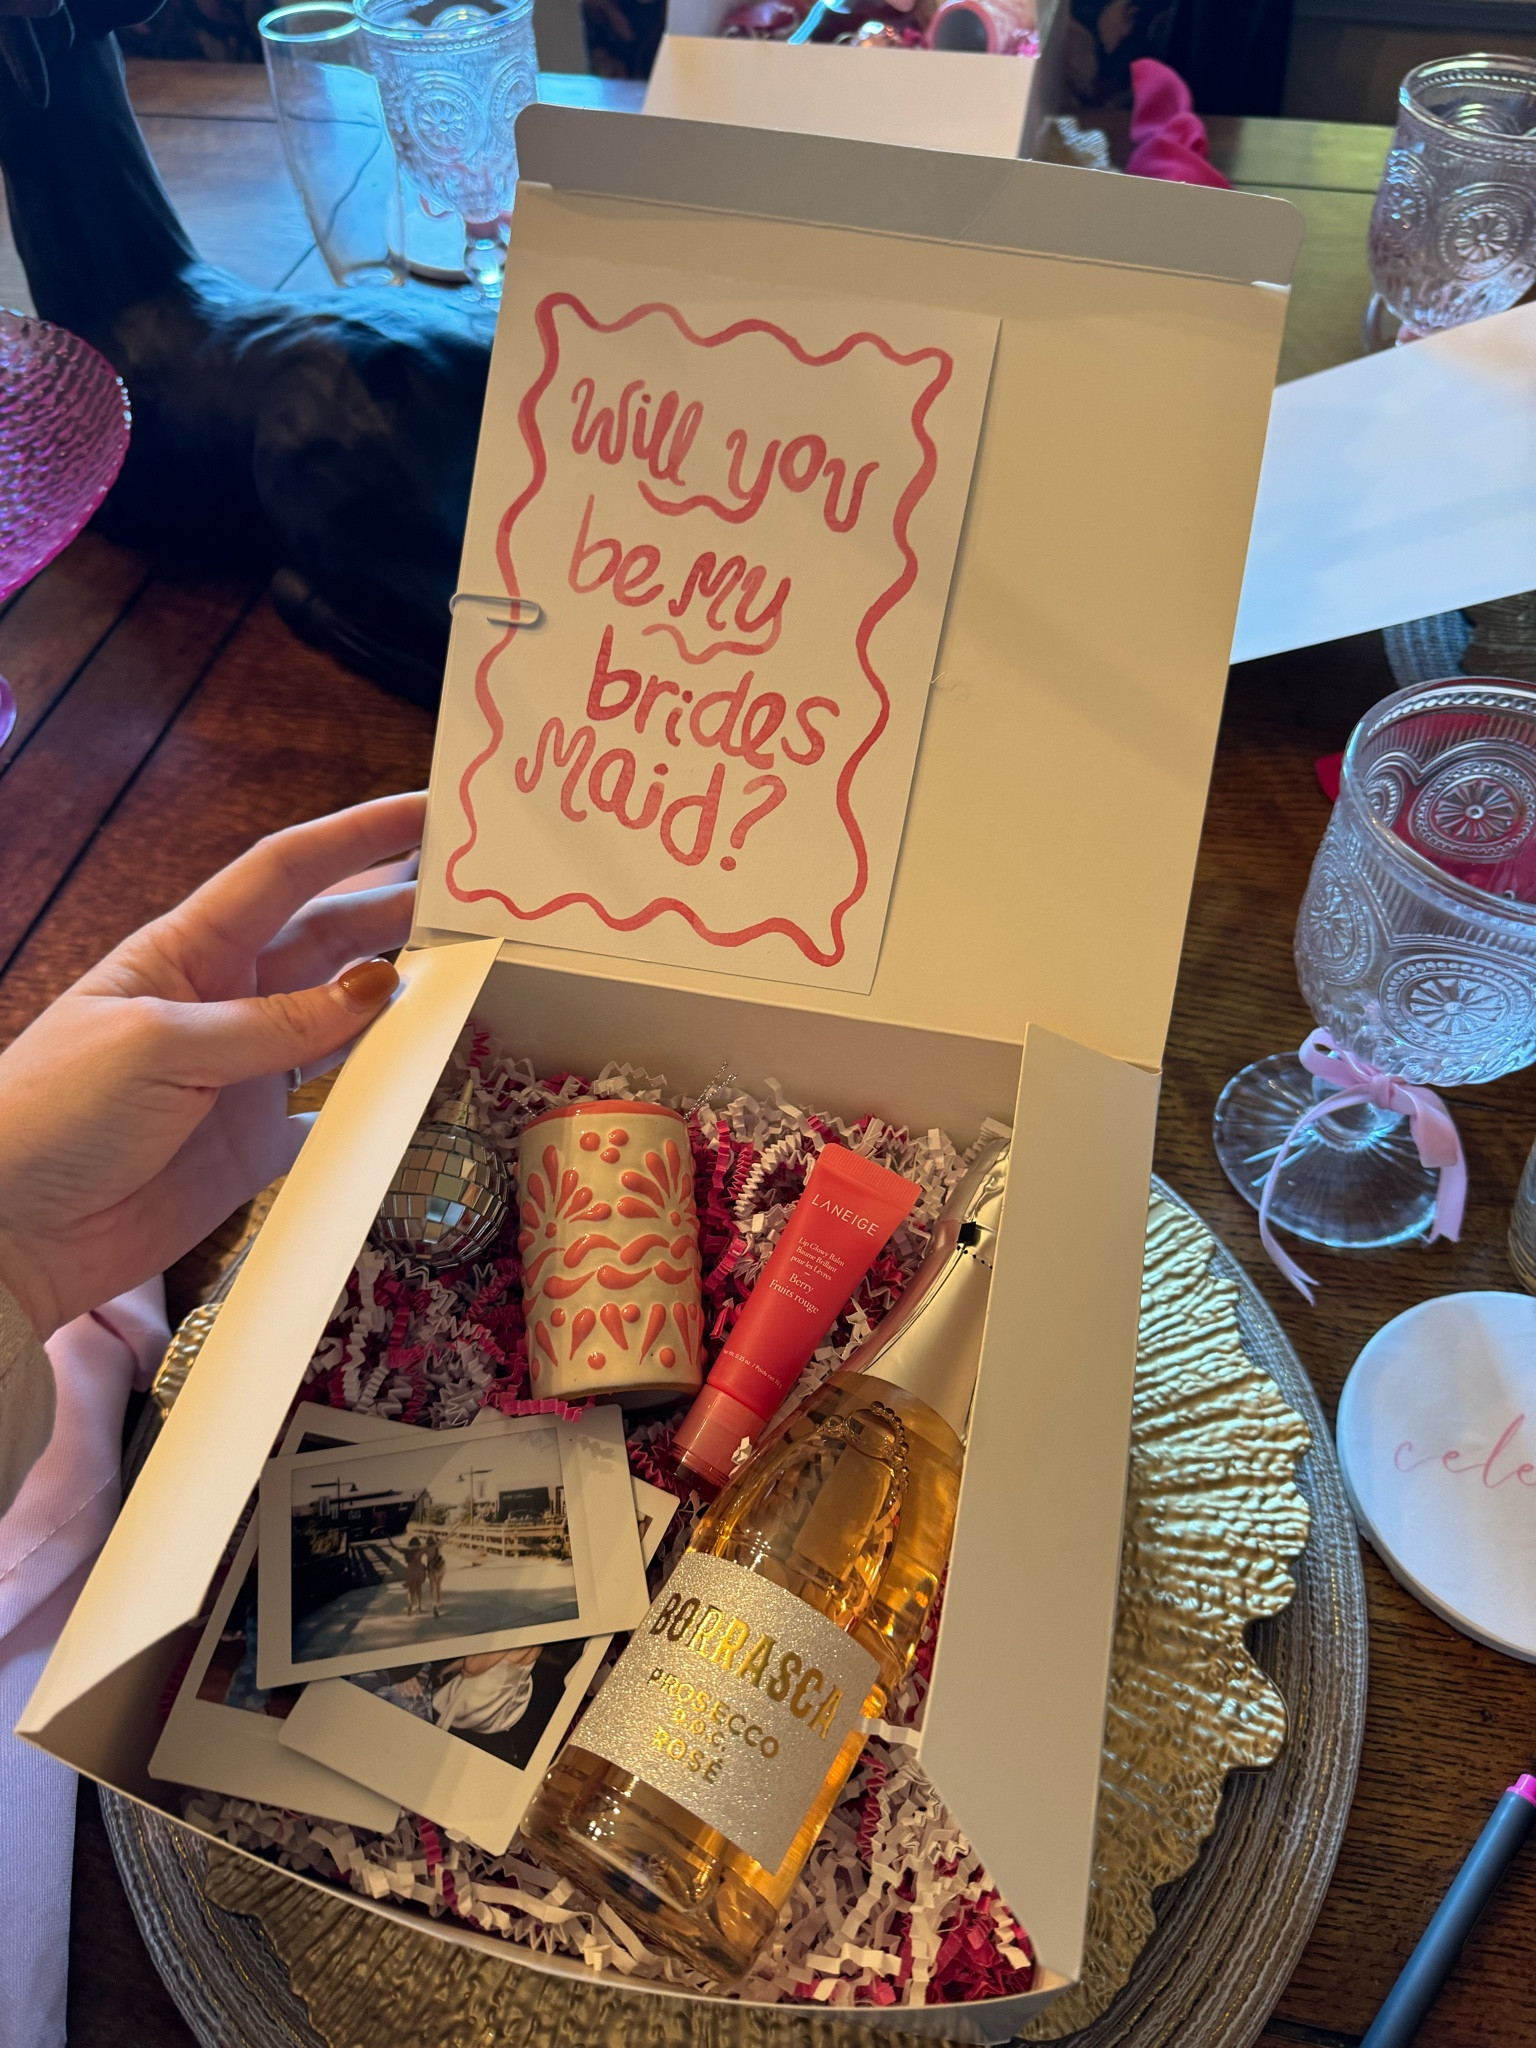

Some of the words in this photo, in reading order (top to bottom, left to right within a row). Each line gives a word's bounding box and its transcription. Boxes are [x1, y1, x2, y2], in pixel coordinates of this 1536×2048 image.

[571, 377, 703, 486] Will
[639, 429, 879, 533] you
[568, 494, 665, 608] be
[586, 624, 841, 771] brides
[811, 1193, 880, 1237] LANEIGE
[790, 1256, 805, 1266] pour
[805, 1261, 814, 1269] les
[796, 1246, 816, 1261] Baume
[816, 1256, 838, 1273] Brillant
[799, 1236, 810, 1248] Lip
[809, 1242, 829, 1258] Glowy
[829, 1253, 845, 1267] Balm
[769, 1279, 793, 1298] Fruits
[794, 1295, 819, 1315] rouge
[789, 1272, 814, 1294] Berry
[650, 1592, 844, 1740] BORRASCA
[646, 1666, 780, 1759] PROSECCO
[651, 1727, 724, 1784] ROSÉ
